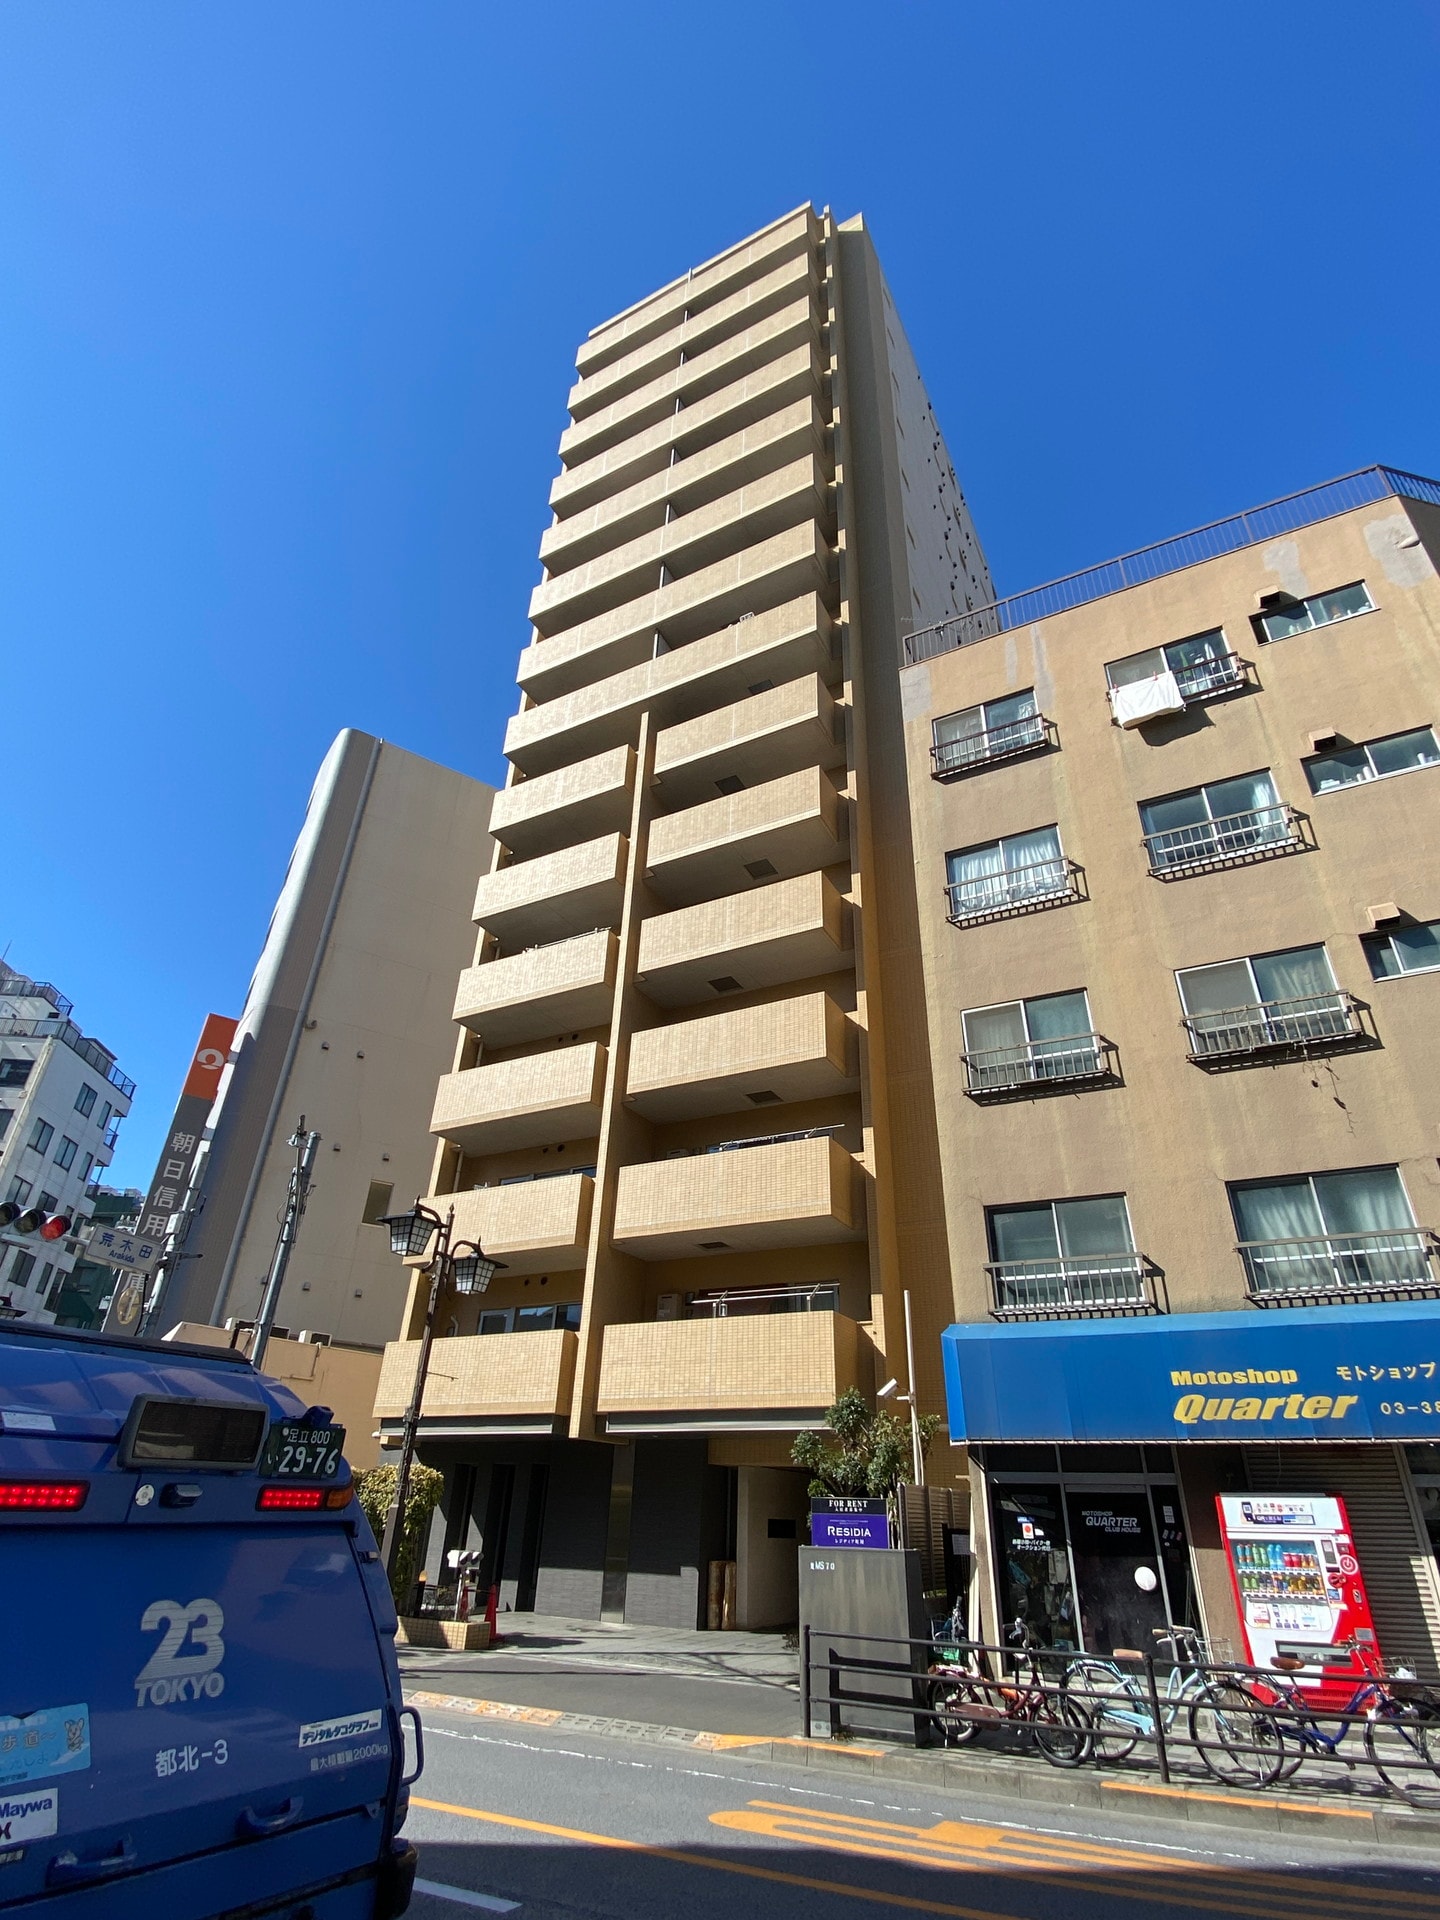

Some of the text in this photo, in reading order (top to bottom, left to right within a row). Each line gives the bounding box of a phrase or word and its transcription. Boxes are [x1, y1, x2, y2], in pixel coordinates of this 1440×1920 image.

[121, 1132, 196, 1293] 朝日信用庫
[99, 1232, 153, 1259] 荒木田
[108, 1249, 135, 1264] Arakida
[1170, 1368, 1299, 1386] Motoshop
[1336, 1361, 1436, 1382] モトショップ
[1173, 1393, 1359, 1424] Quarter
[287, 1428, 331, 1445] 足立 800
[267, 1453, 279, 1465] い
[278, 1445, 339, 1474] 29-76
[829, 1499, 868, 1508] FOR RENT
[827, 1525, 872, 1538] RESIDIA
[1085, 1516, 1138, 1527] QUARTER
[136, 1598, 225, 1681] 23
[134, 1672, 225, 1707] TOKYO
[155, 1739, 229, 1778] 都北-3
